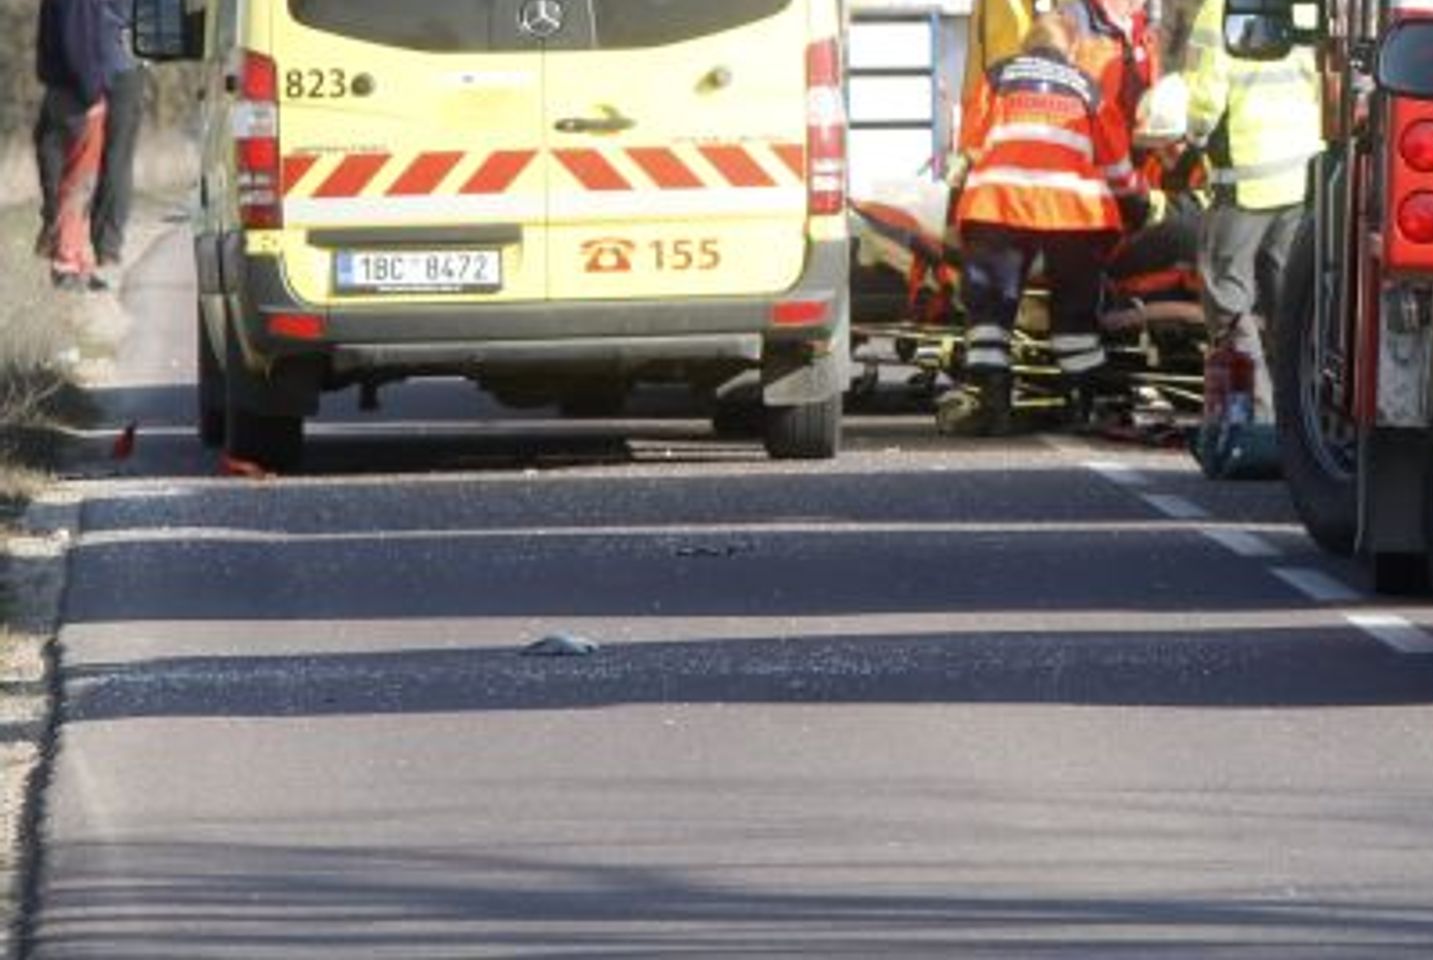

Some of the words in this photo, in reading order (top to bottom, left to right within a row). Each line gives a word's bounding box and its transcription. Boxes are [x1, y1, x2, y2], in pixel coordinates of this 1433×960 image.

[285, 67, 346, 99] 823
[361, 256, 403, 281] 1BC
[425, 254, 488, 281] 8472
[648, 239, 721, 270] 155
